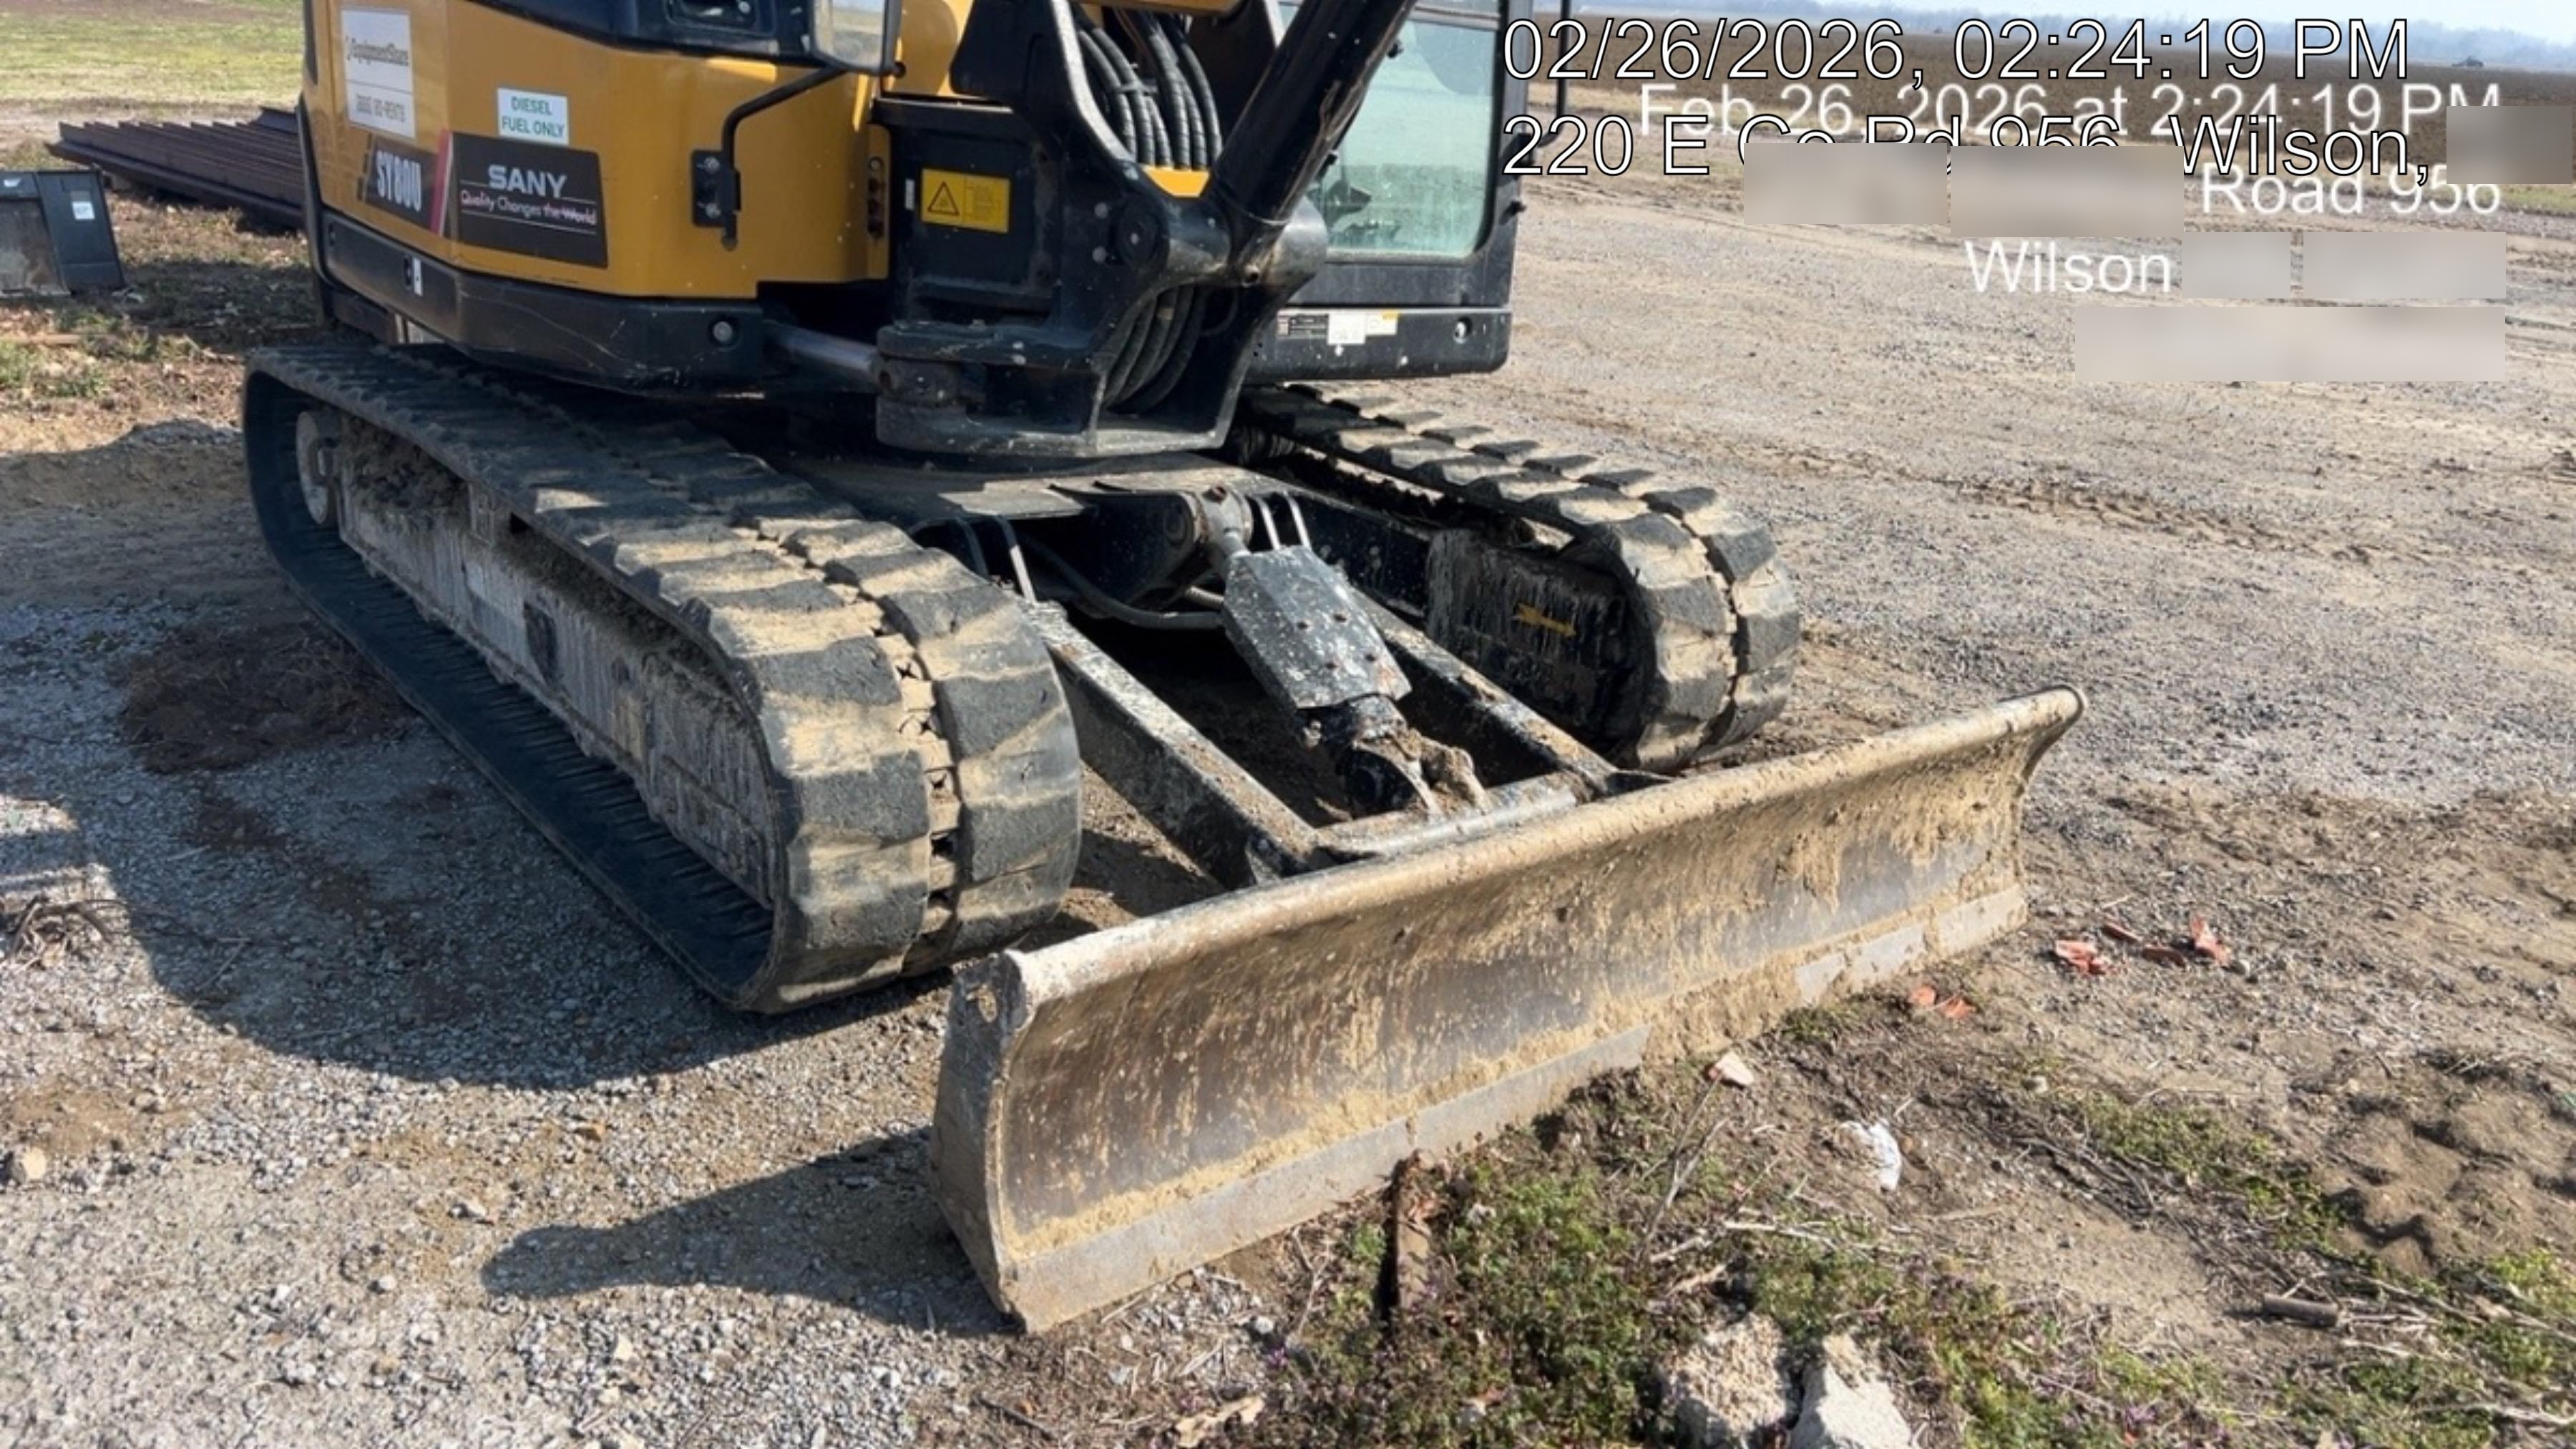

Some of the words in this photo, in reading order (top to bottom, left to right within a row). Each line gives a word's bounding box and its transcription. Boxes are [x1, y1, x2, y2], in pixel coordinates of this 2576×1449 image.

[510, 96, 553, 116] DIESEL
[502, 115, 531, 134] FUEL
[533, 120, 565, 138] ONLY
[488, 164, 567, 199] SANY
[460, 190, 495, 213] Quality
[497, 195, 542, 218] Changes
